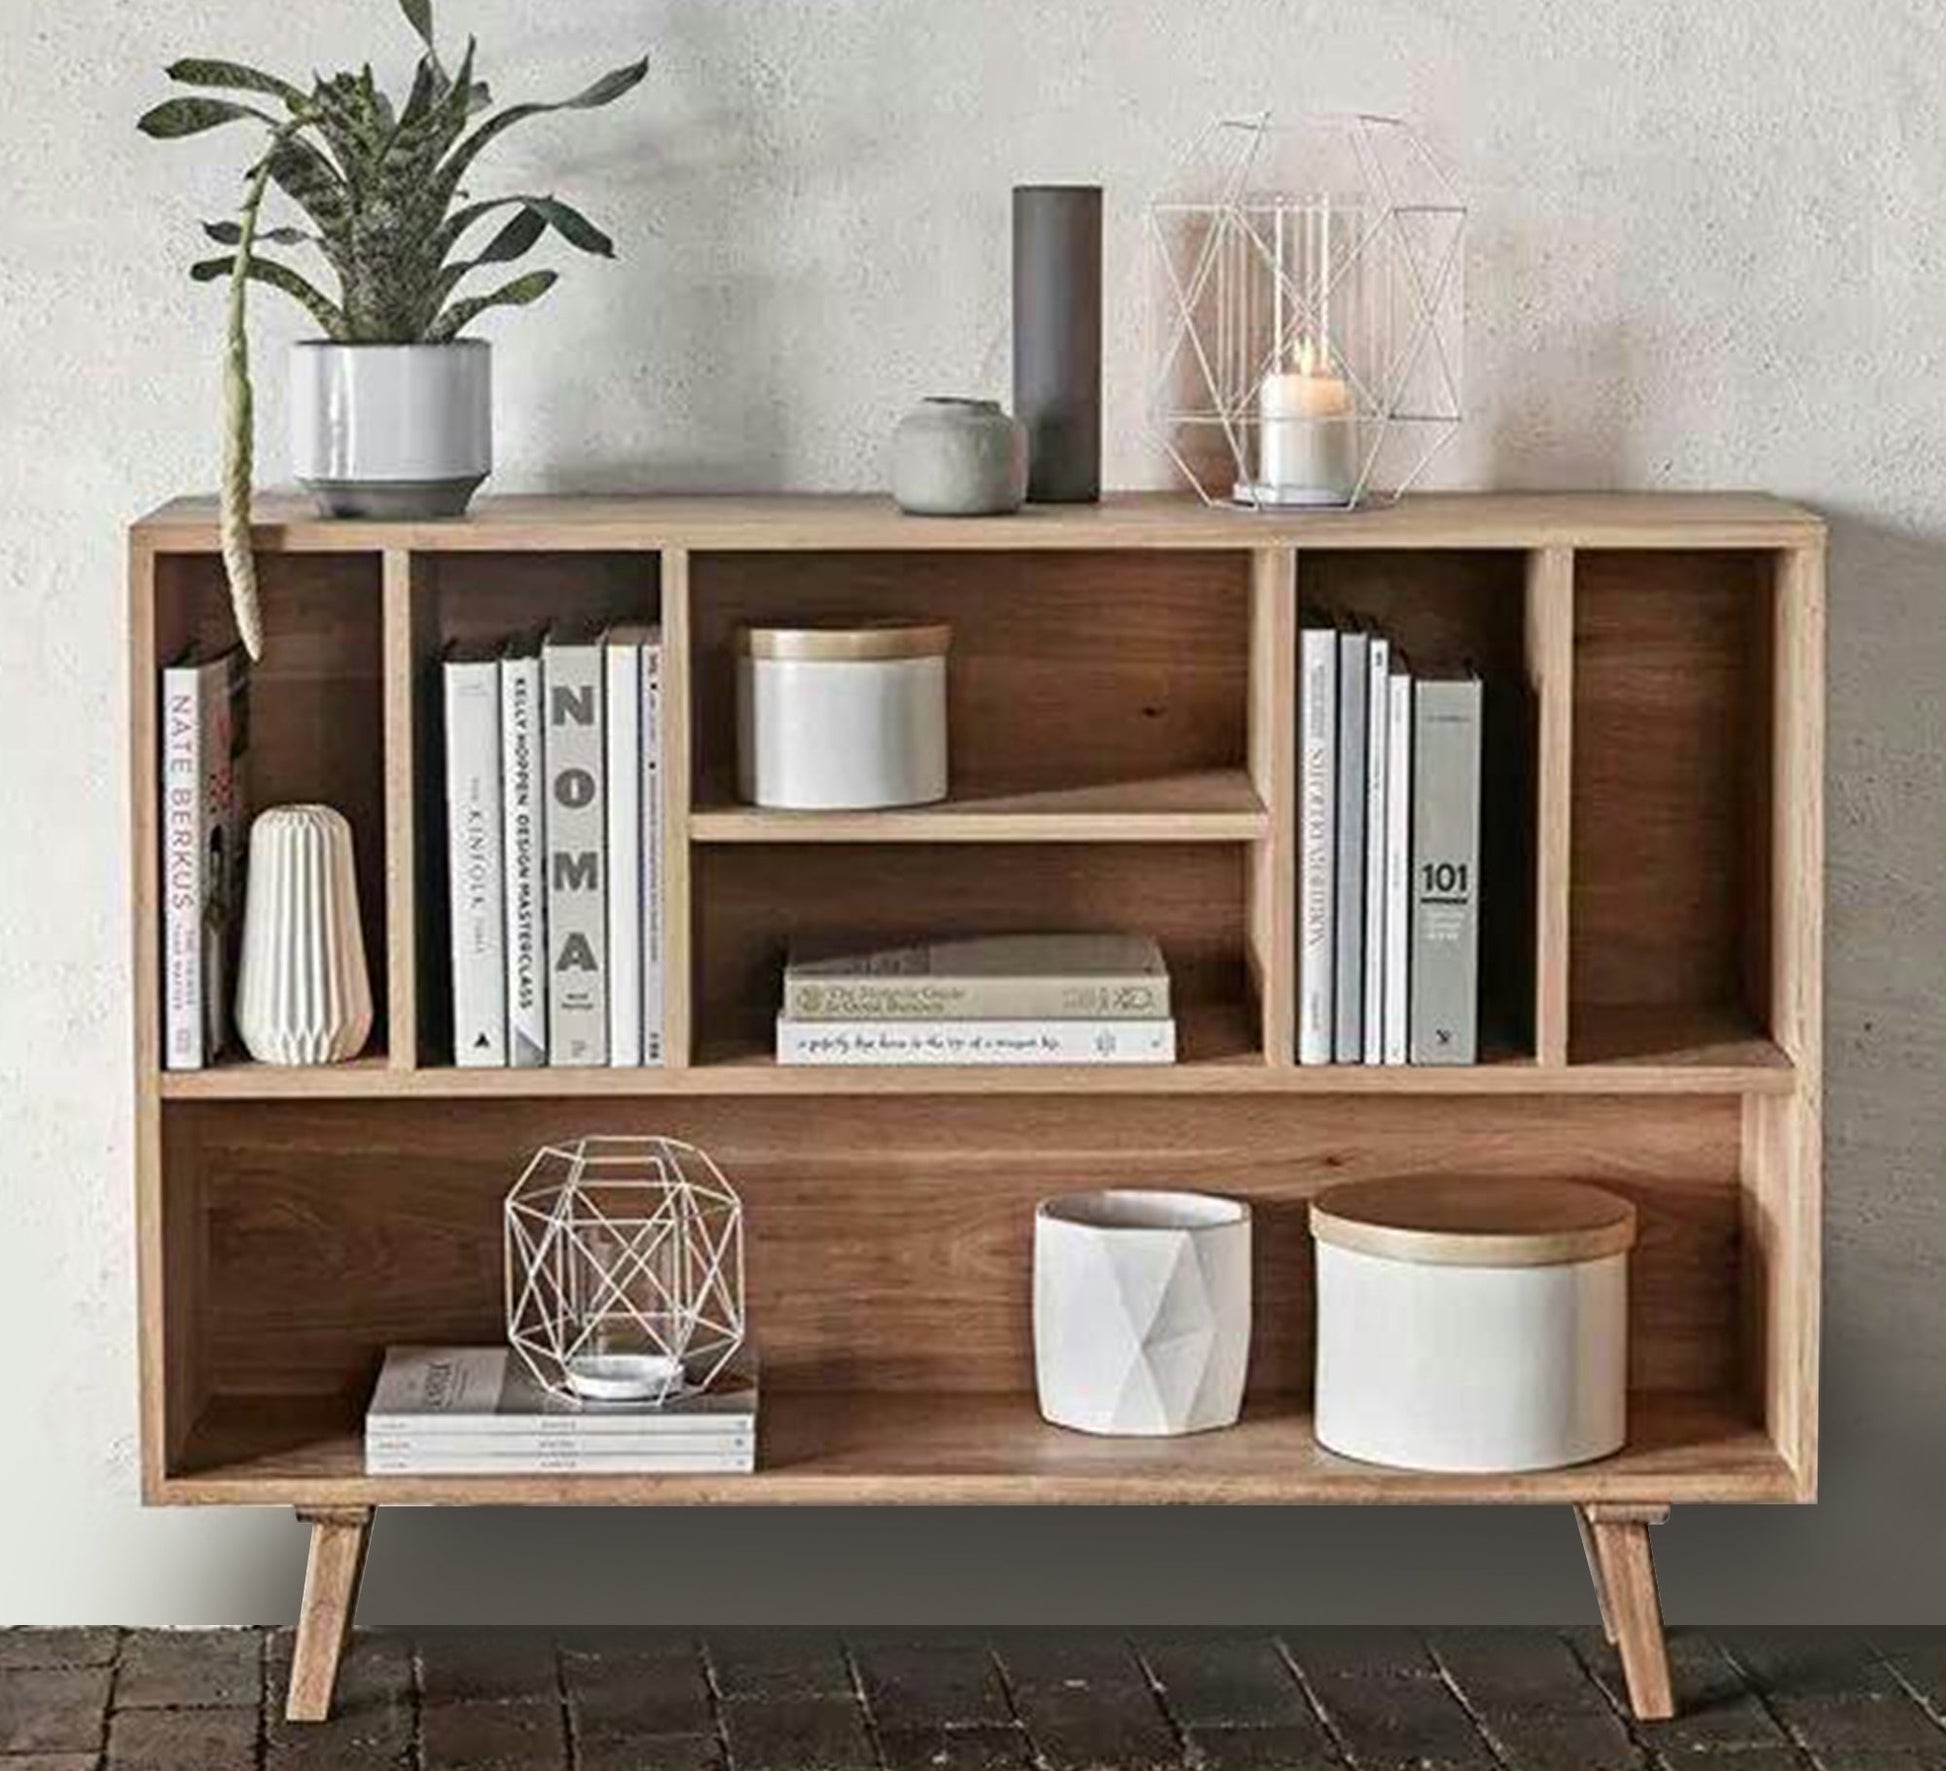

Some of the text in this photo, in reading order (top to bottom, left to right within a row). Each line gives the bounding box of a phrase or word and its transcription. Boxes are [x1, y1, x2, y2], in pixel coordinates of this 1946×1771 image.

[171, 694, 194, 909] NATE BERKUS
[468, 810, 486, 908] KINFOLK
[514, 677, 533, 1010] KELLY HOPPEN DESIGN MASTERCLASS
[551, 685, 599, 972] NOMA
[1422, 862, 1467, 893] 101
